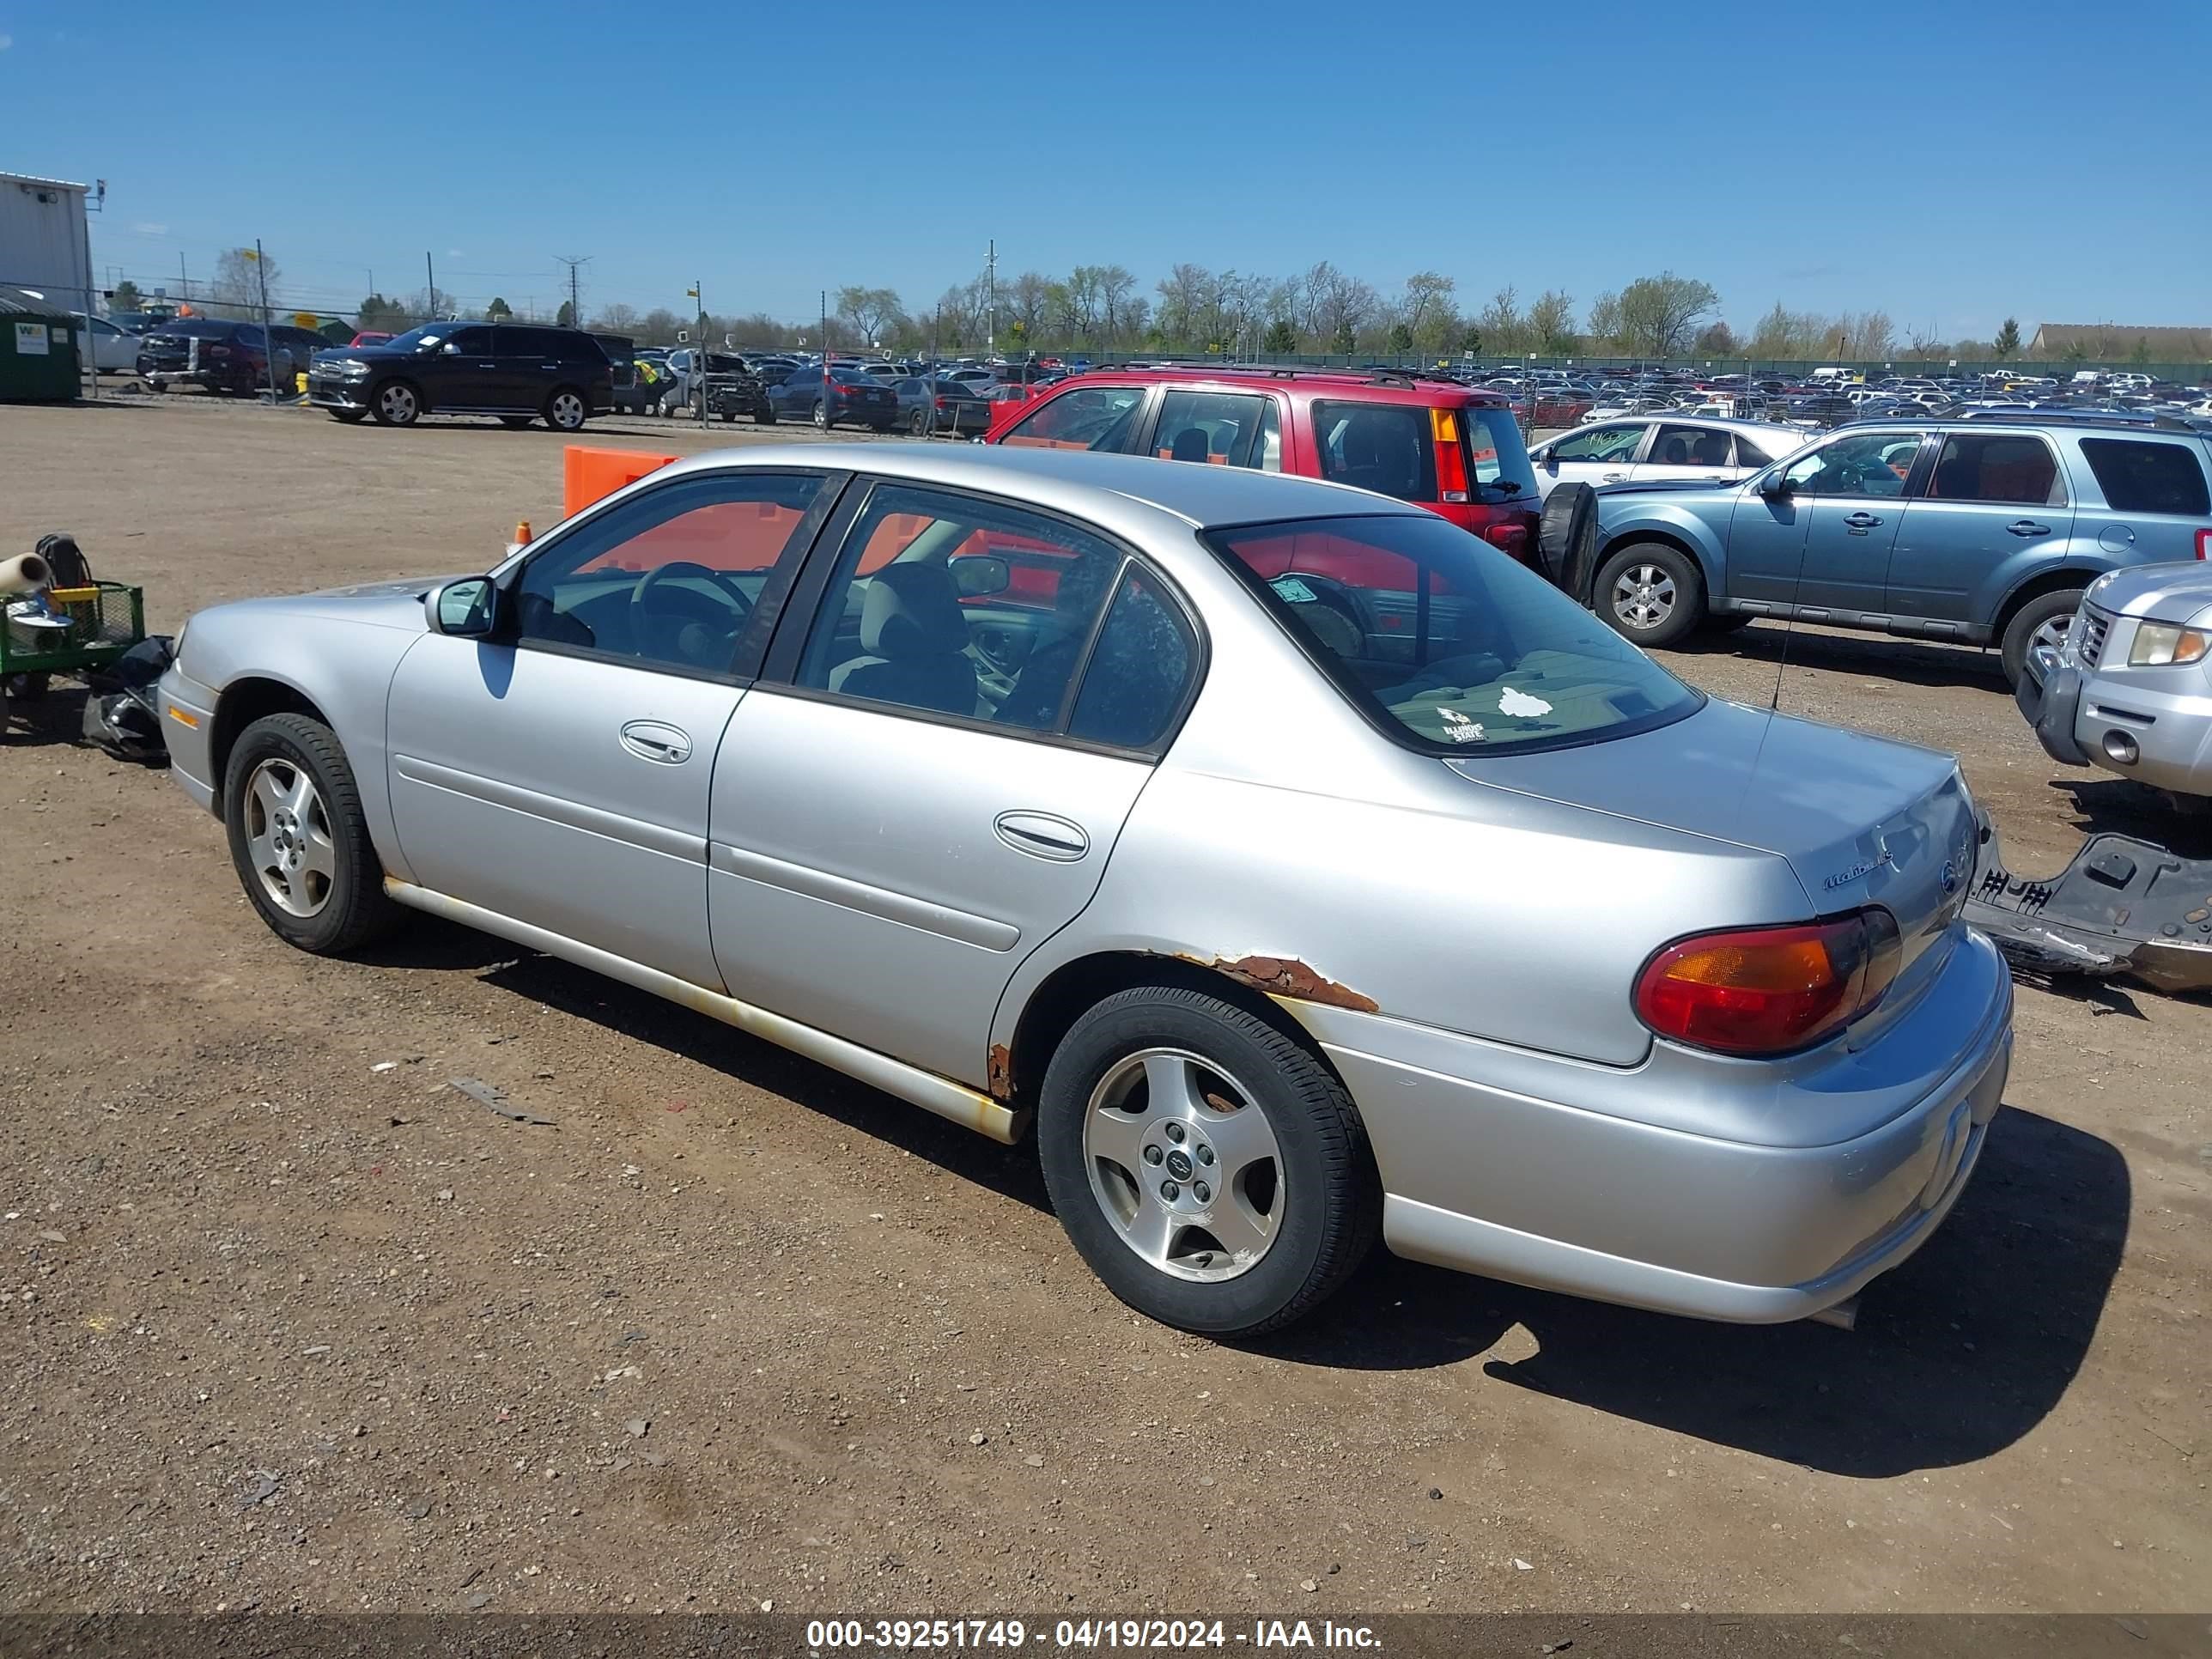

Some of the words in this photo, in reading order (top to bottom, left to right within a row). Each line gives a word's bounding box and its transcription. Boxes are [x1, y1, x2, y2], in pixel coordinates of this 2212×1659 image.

[1443, 723, 1484, 735] ILLINOIS
[1453, 731, 1483, 742] STATE
[1823, 862, 1878, 890] Malibu
